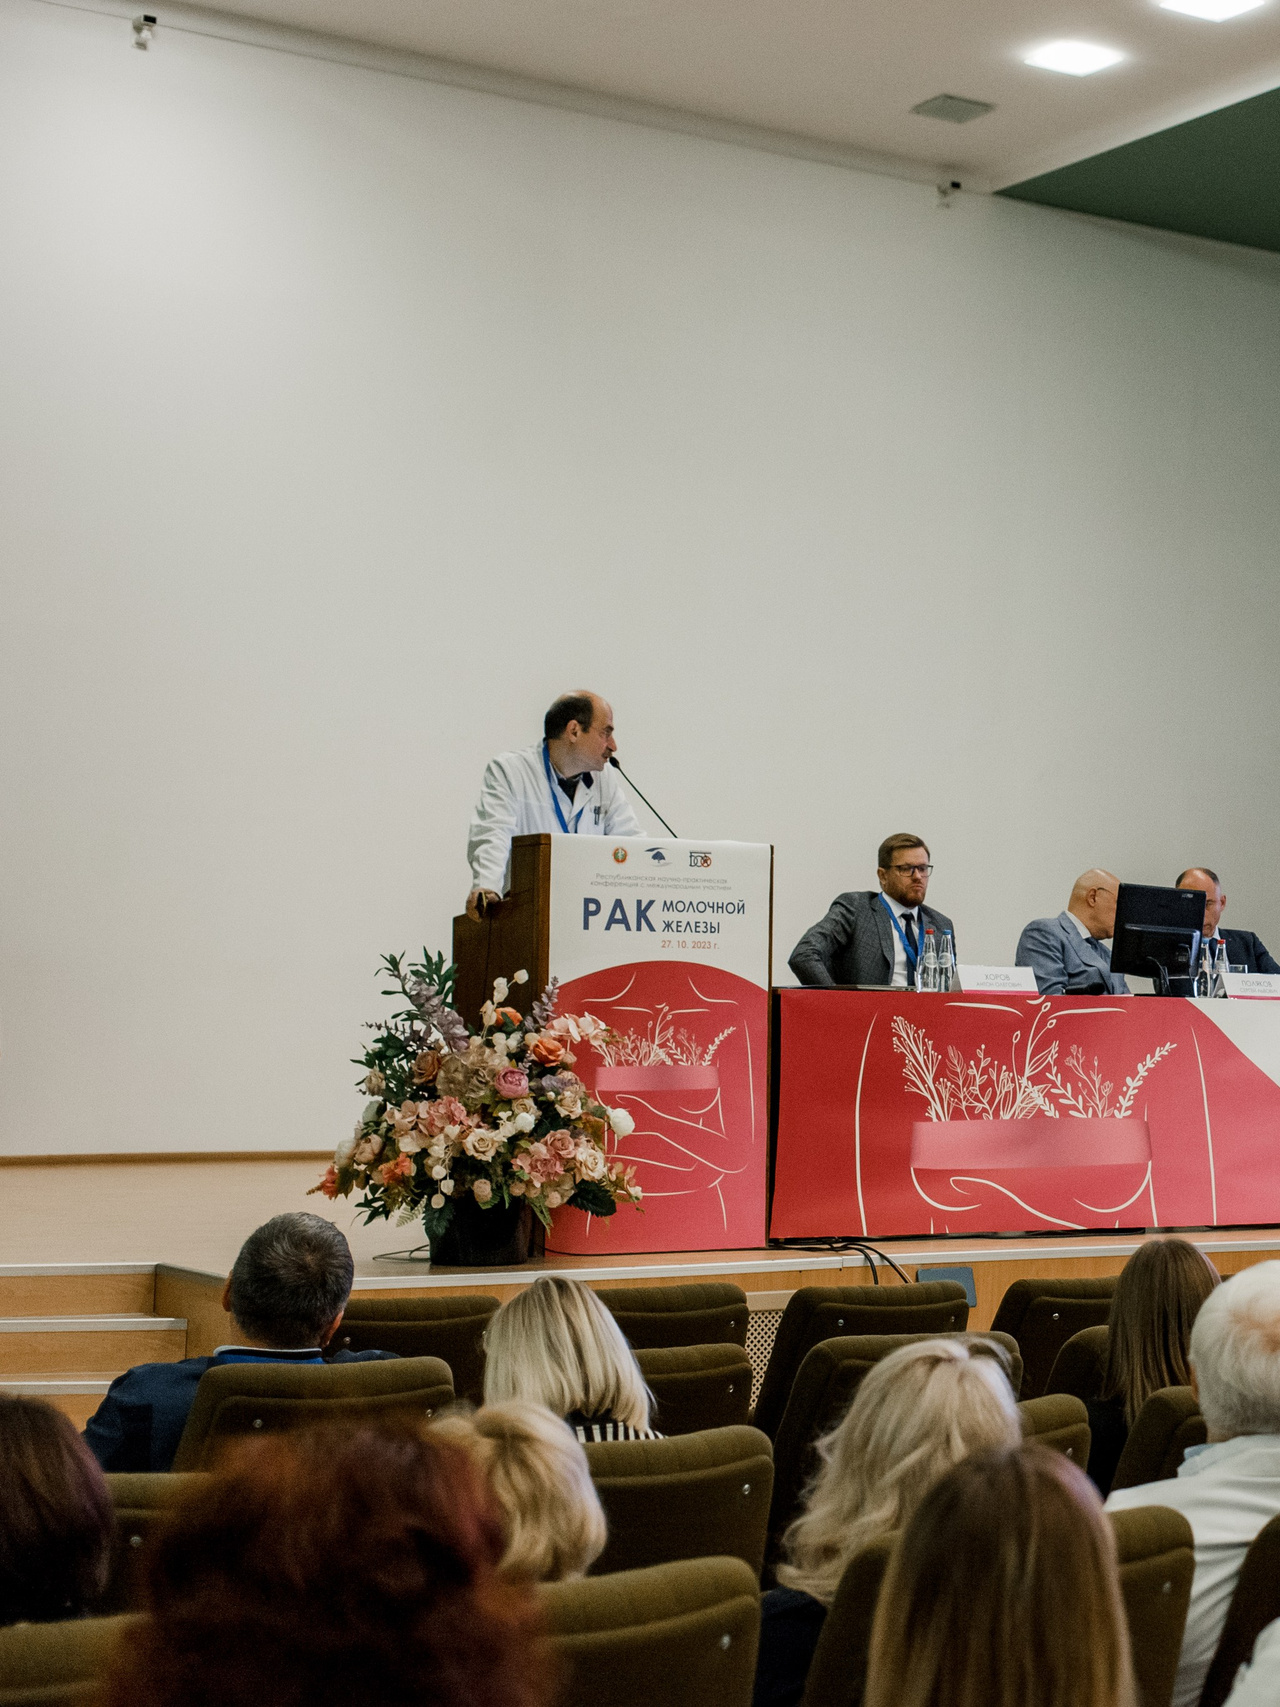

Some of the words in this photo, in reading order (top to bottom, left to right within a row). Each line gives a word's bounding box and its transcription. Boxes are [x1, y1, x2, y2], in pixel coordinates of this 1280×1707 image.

[583, 897, 656, 932] РАК
[662, 899, 745, 915] МОЛОЧНОЙ
[662, 920, 720, 934] ЖЕЛЕЗЫ
[691, 941, 712, 950] 2023
